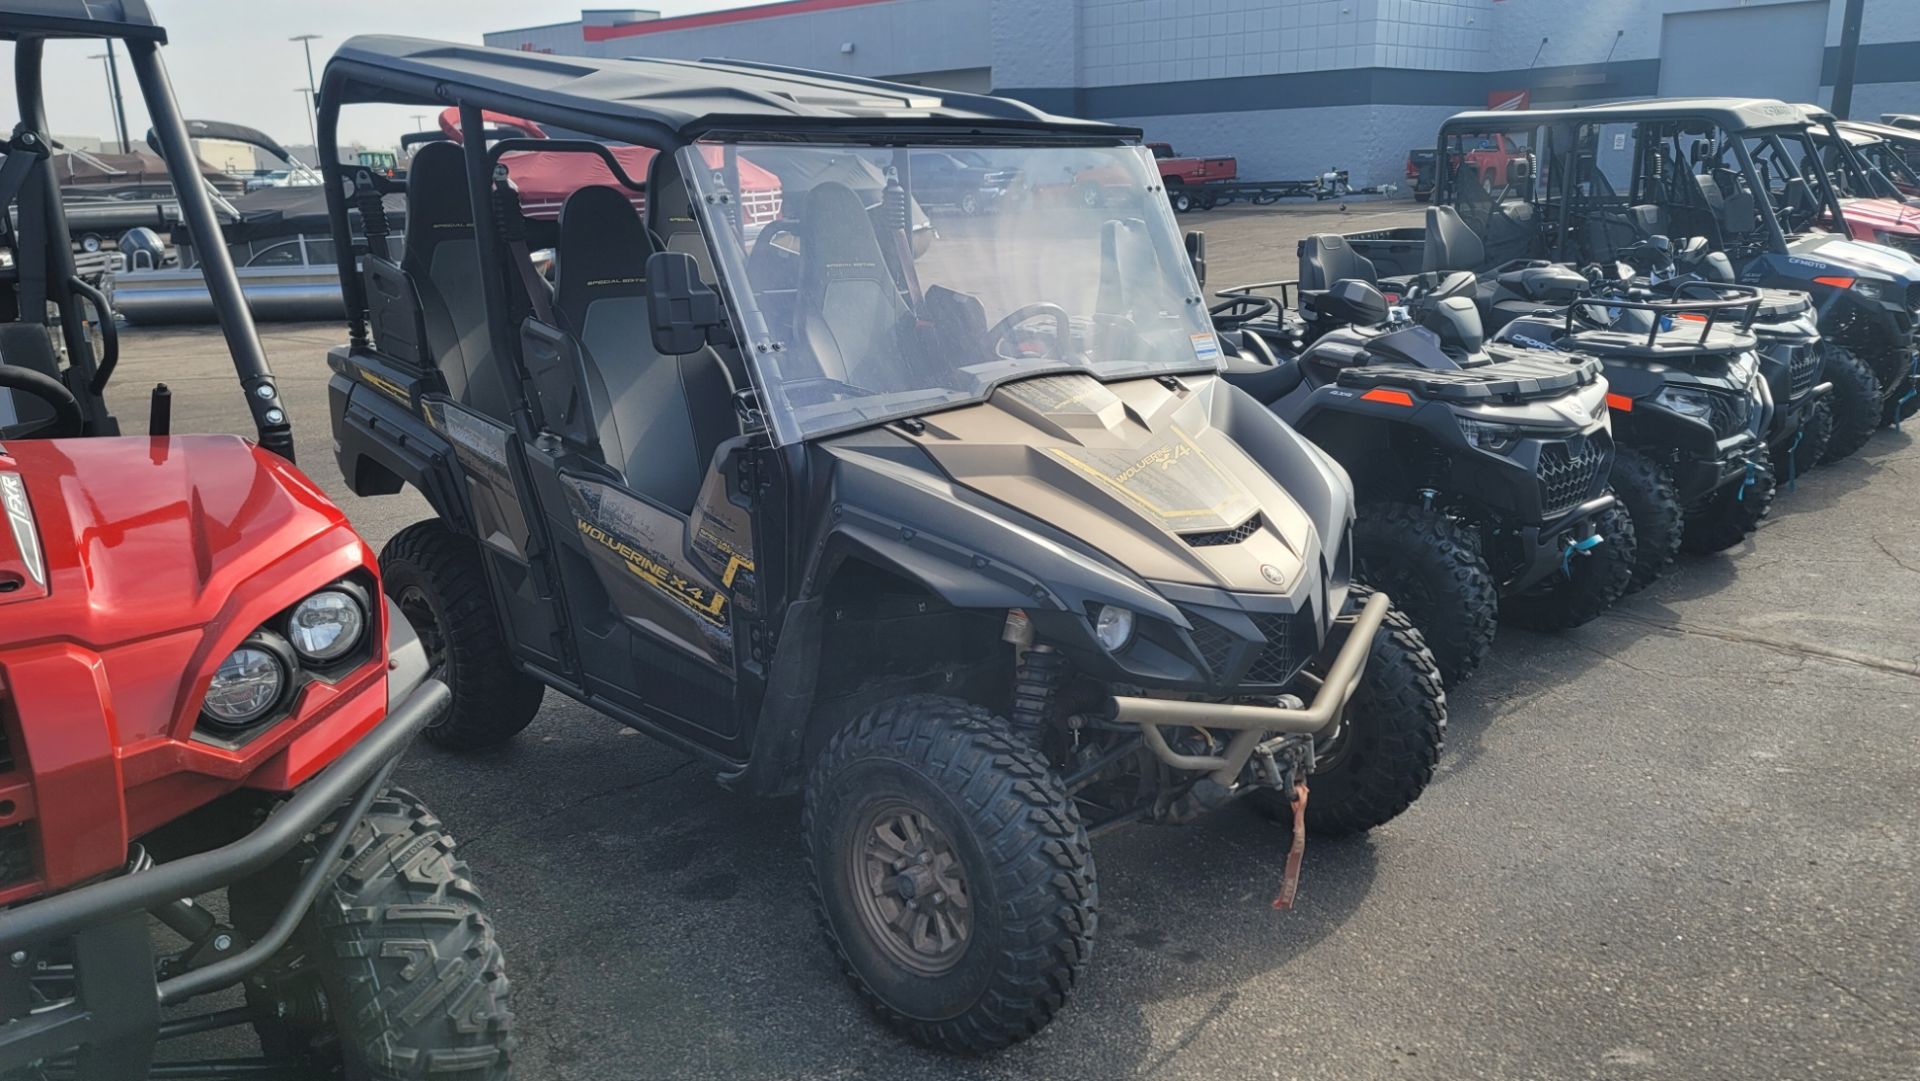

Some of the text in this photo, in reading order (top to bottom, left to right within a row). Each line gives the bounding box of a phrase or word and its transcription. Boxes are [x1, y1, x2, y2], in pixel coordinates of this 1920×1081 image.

[1788, 257, 1827, 269] CFMOTO
[1512, 333, 1560, 352] CFORC
[1115, 446, 1171, 484] WOLVERINE
[1, 474, 27, 518] FXR
[576, 517, 670, 580] WOLVERINE
